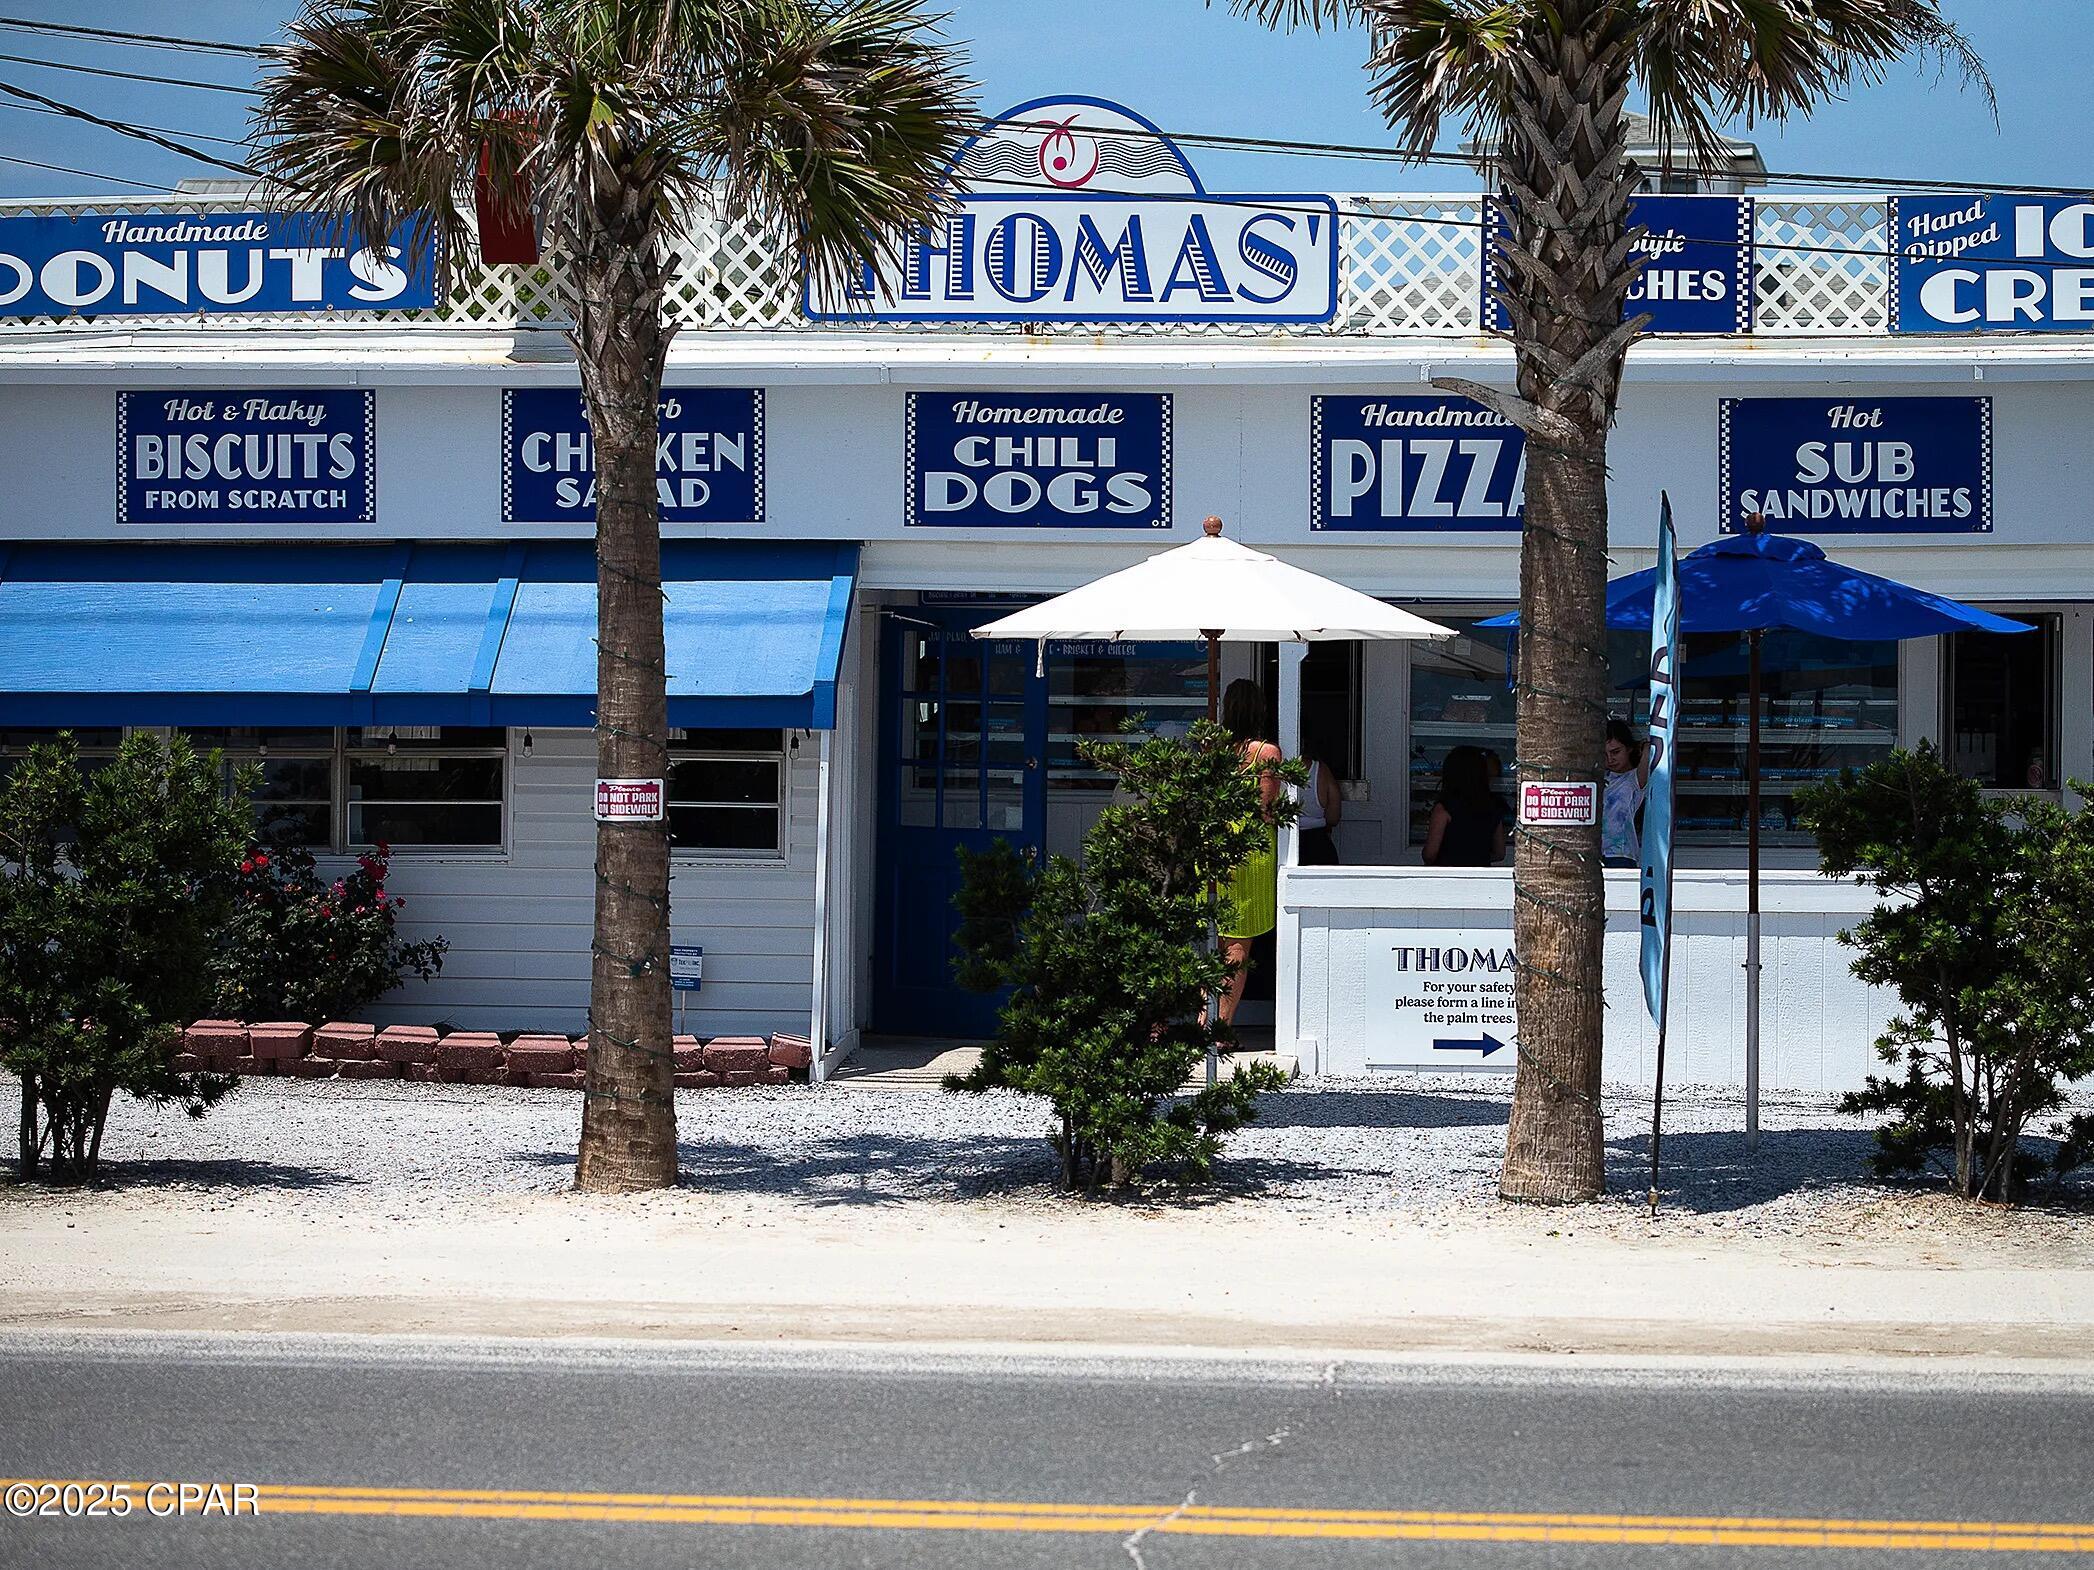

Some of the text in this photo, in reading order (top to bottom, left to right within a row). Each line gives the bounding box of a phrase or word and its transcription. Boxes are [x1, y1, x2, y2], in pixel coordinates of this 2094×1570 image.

[1907, 200, 1986, 238] Hand
[100, 219, 270, 244] Handmade
[1903, 222, 2002, 265] Dipped
[163, 398, 327, 427] Hot & Flaky
[951, 401, 1125, 424] Homemade
[1827, 405, 1884, 428] Hot
[136, 433, 356, 480] BISCUITS
[521, 432, 745, 472] CHKEN
[953, 436, 1116, 467] CHILI
[1795, 441, 1915, 484] SUB
[145, 489, 347, 509] FROM SCRATCH
[924, 471, 1152, 514] DOGS
[1740, 487, 1973, 519] SANDWICHES
[1107, 644, 1137, 656] CHEESE
[598, 792, 658, 803] DO NOT PARK
[1526, 795, 1590, 807] DO NOT PARK
[1540, 788, 1574, 796] Please
[598, 803, 658, 815] ON SIDEWALK
[1526, 807, 1589, 818] ON SIDEWALK
[1423, 981, 1516, 996] For your safety
[1395, 996, 1435, 1010] please
[1437, 996, 1468, 1009] form
[1470, 1000, 1479, 1008] a
[1481, 997, 1505, 1009] line
[1423, 1011, 1516, 1025] the palm trees.
